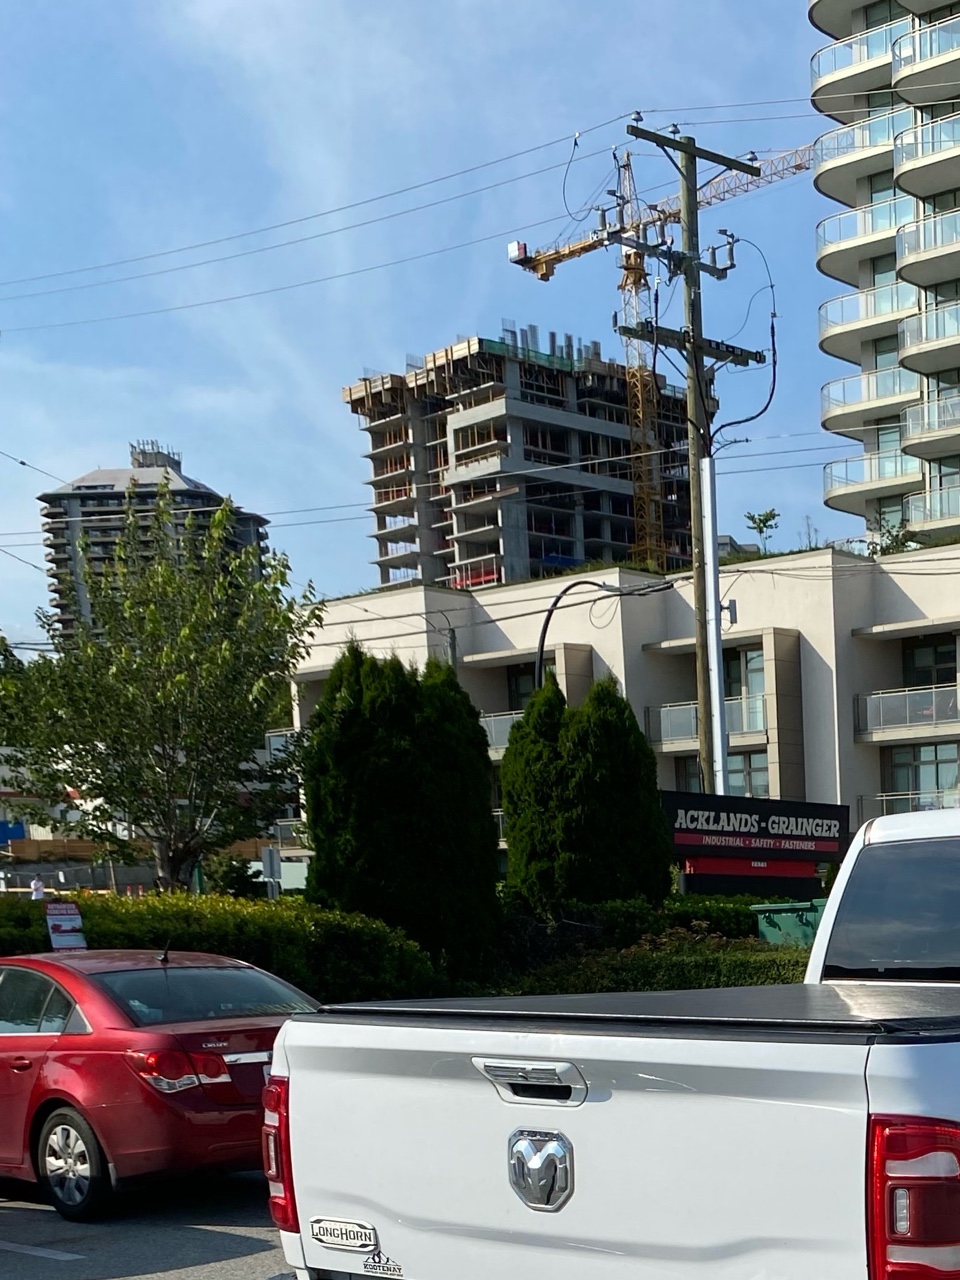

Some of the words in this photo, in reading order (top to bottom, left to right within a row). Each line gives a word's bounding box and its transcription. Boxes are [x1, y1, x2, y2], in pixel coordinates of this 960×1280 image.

[702, 836, 744, 847] INDUSTRIAL
[751, 838, 775, 849] SAFETY
[781, 841, 816, 850] FASTENERS
[363, 1263, 402, 1274] KOOTENAY
